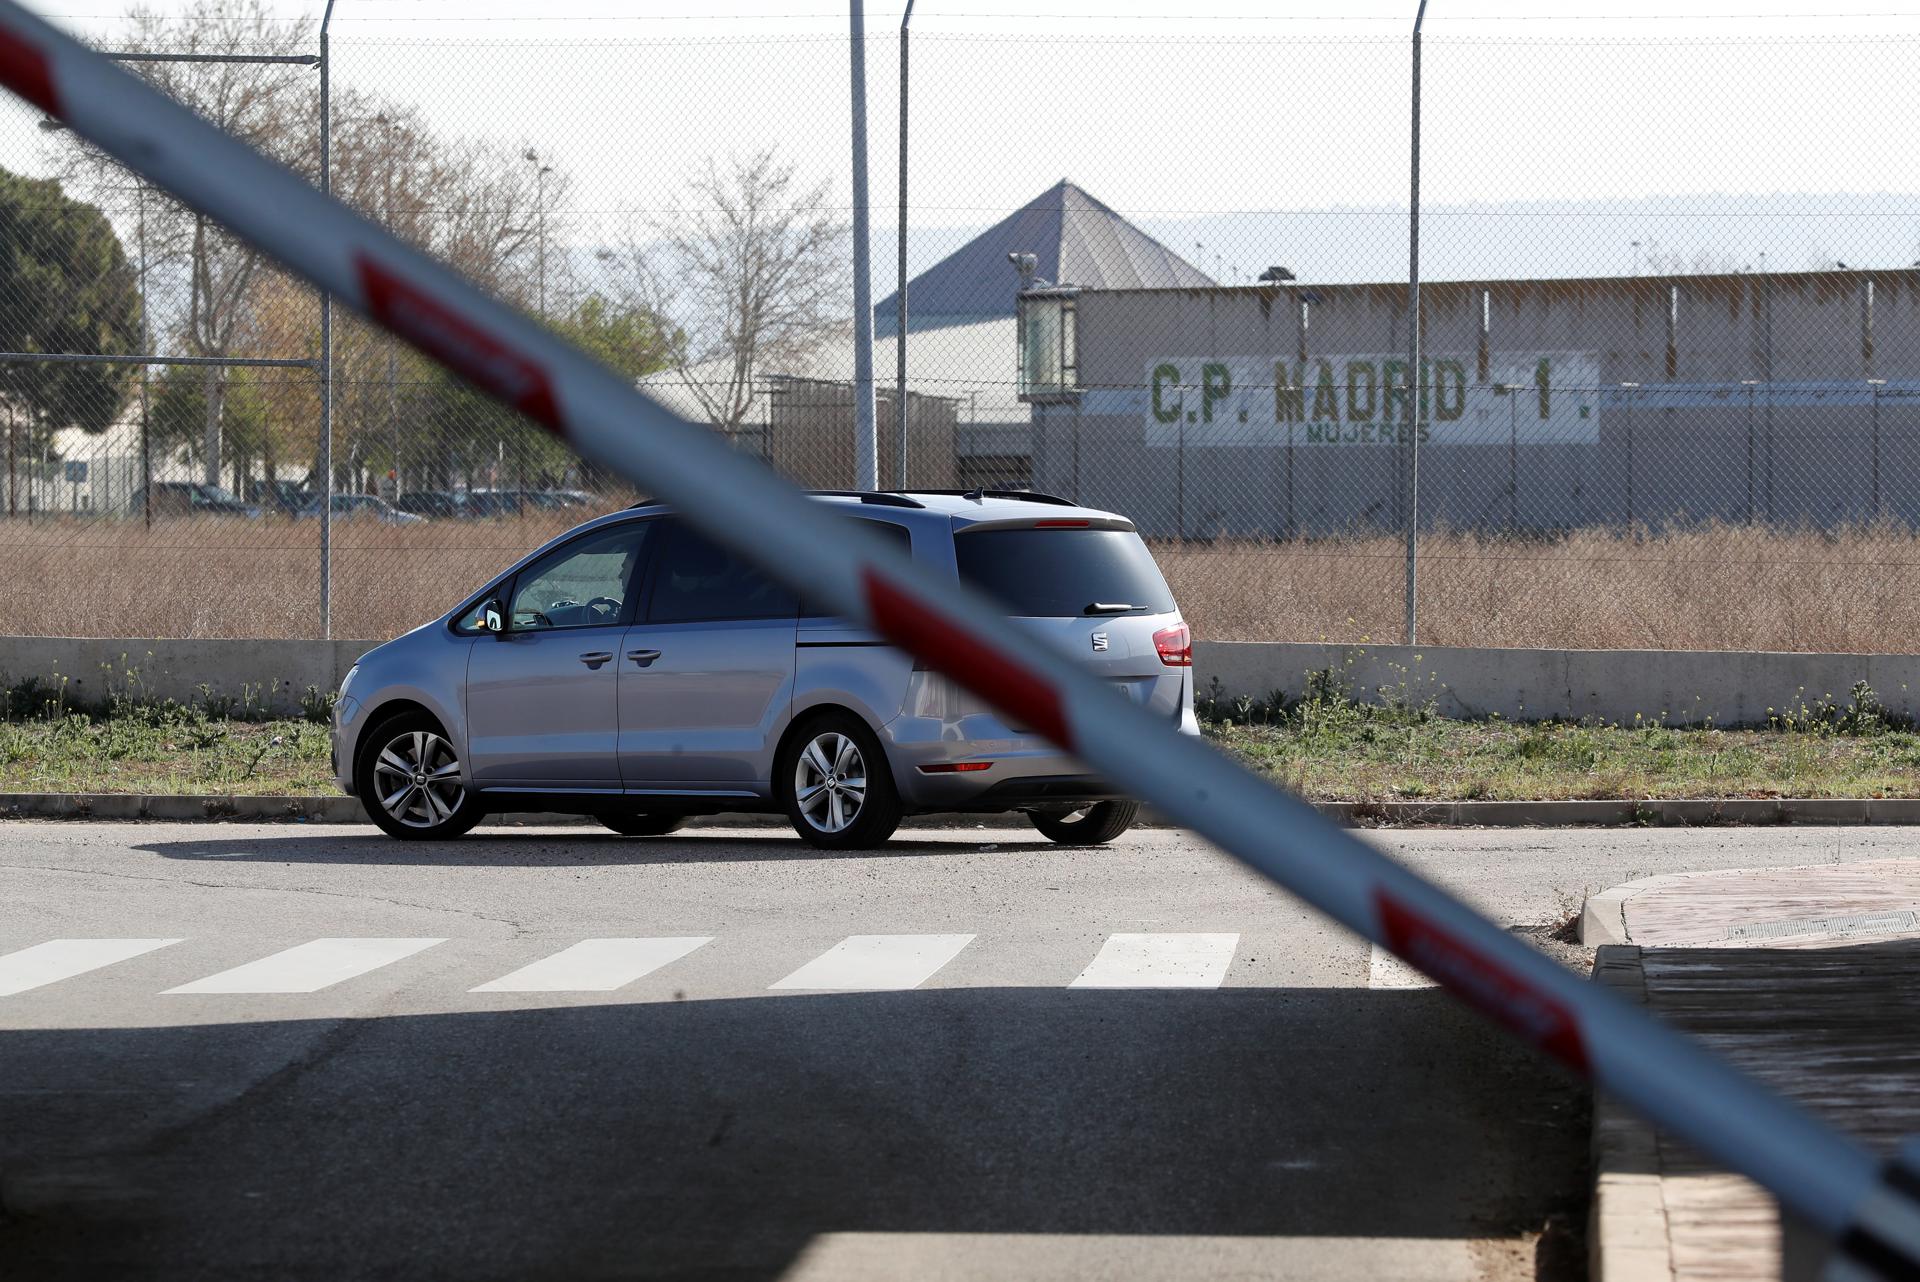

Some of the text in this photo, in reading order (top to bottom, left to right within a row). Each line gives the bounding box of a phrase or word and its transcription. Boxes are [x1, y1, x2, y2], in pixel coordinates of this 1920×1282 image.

[1152, 362, 1248, 424] C.P.
[1275, 358, 1466, 423] MADRID
[1307, 424, 1429, 444] MUJERES
